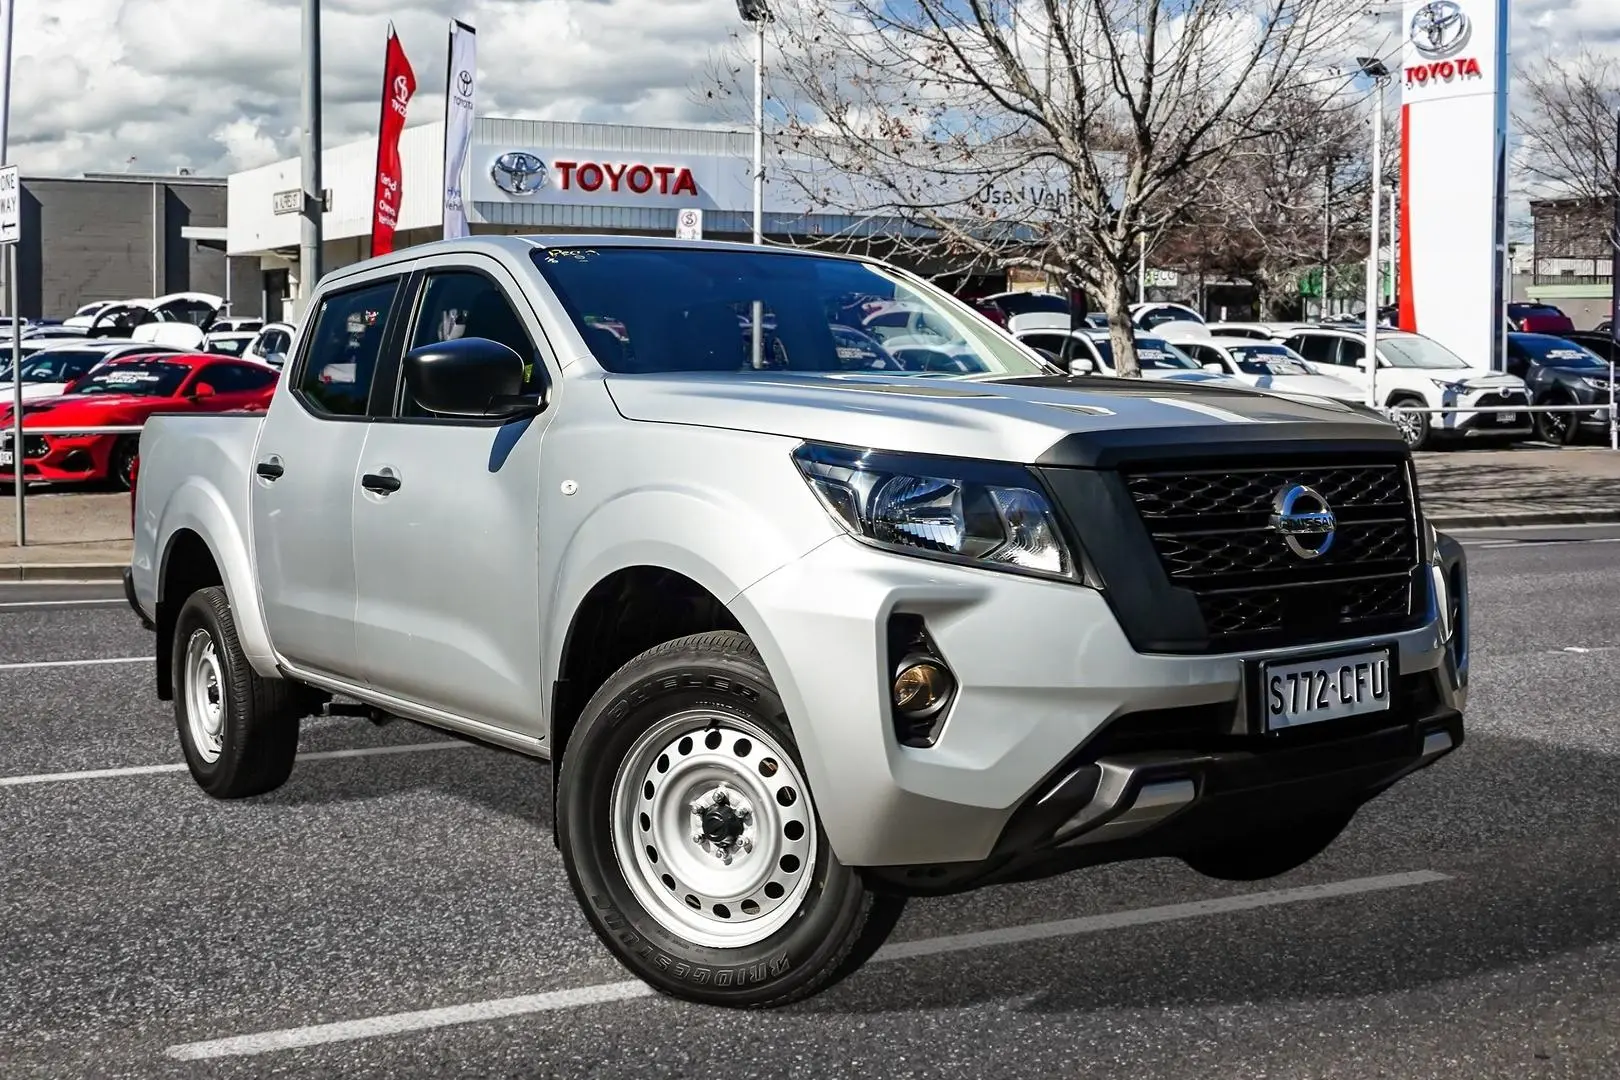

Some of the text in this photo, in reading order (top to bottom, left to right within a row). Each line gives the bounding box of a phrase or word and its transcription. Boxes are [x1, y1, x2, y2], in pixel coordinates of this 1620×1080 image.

[1404, 58, 1481, 83] TOYOTA
[555, 161, 698, 196] TOYOTA
[1291, 515, 1335, 528] NISSAN
